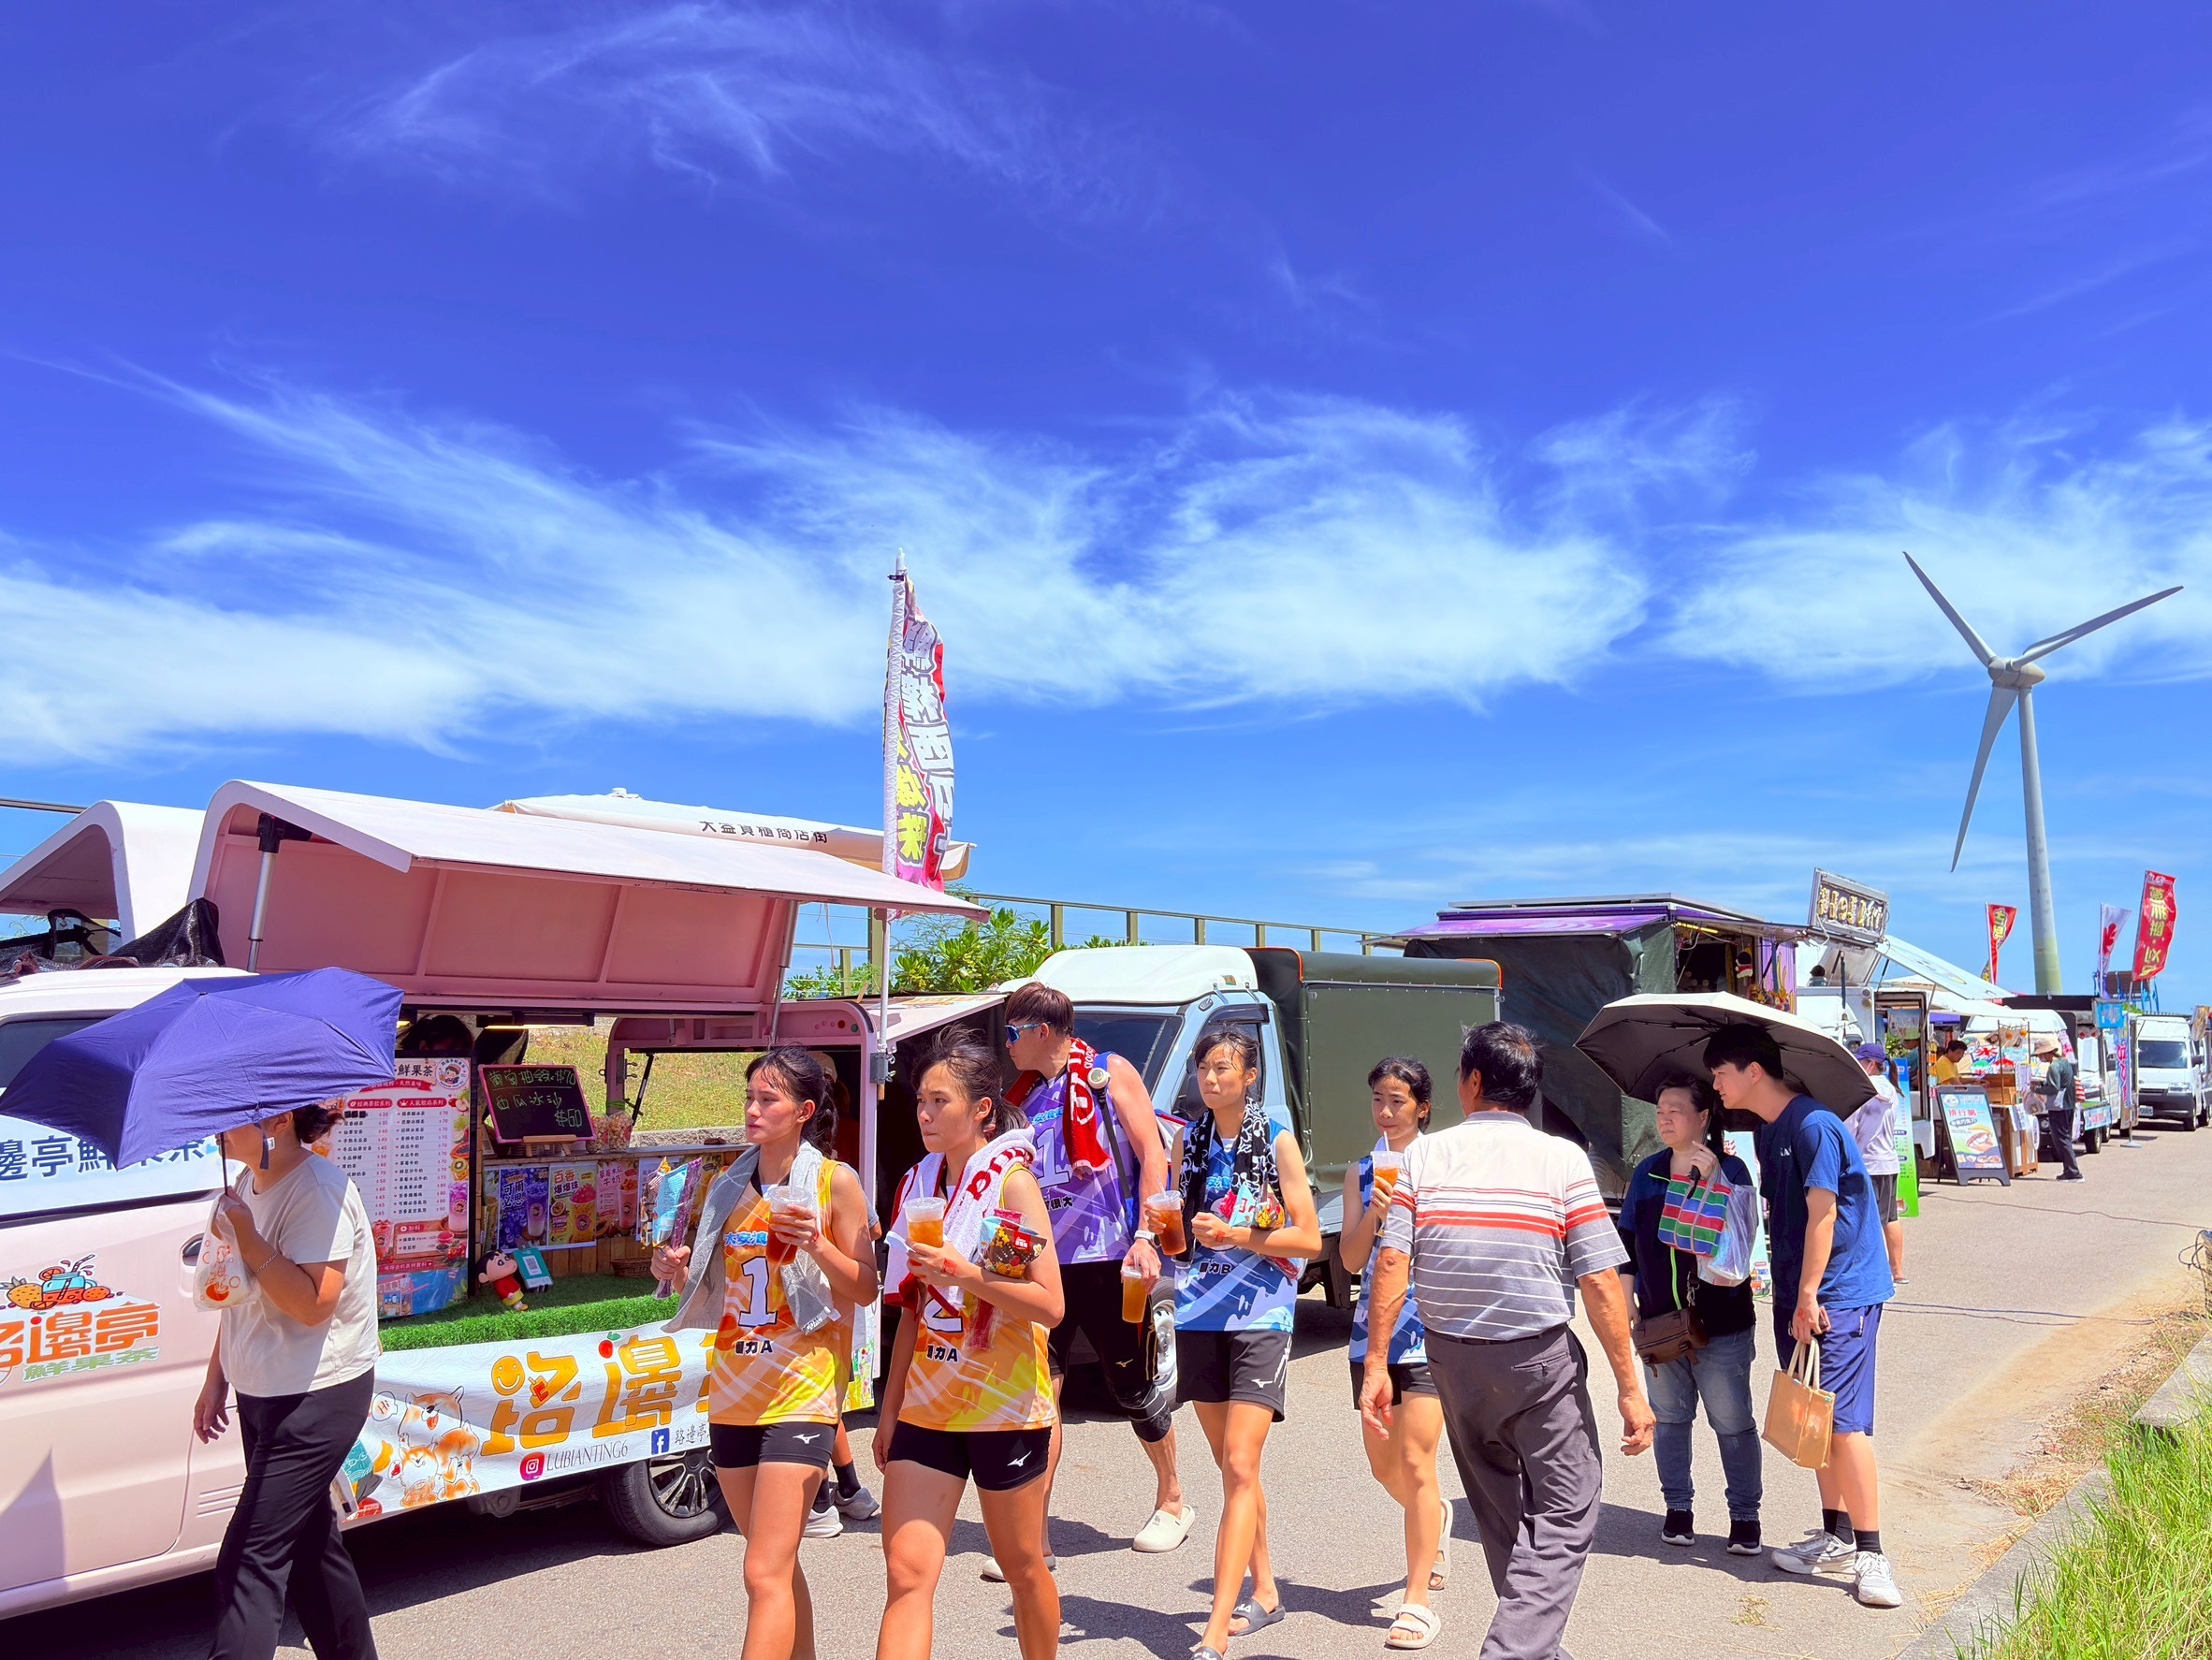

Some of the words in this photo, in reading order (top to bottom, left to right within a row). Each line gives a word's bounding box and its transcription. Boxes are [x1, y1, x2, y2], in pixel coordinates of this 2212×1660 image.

[394, 1063, 433, 1076] 鮮果茶
[496, 1091, 562, 1110] 西瓜冰沙
[553, 1170, 575, 1184] 百香
[738, 1256, 778, 1327] 1
[24, 1347, 160, 1380] 鮮果茶
[377, 1399, 390, 1415] Hi
[546, 1440, 628, 1471] LUBIANTING6
